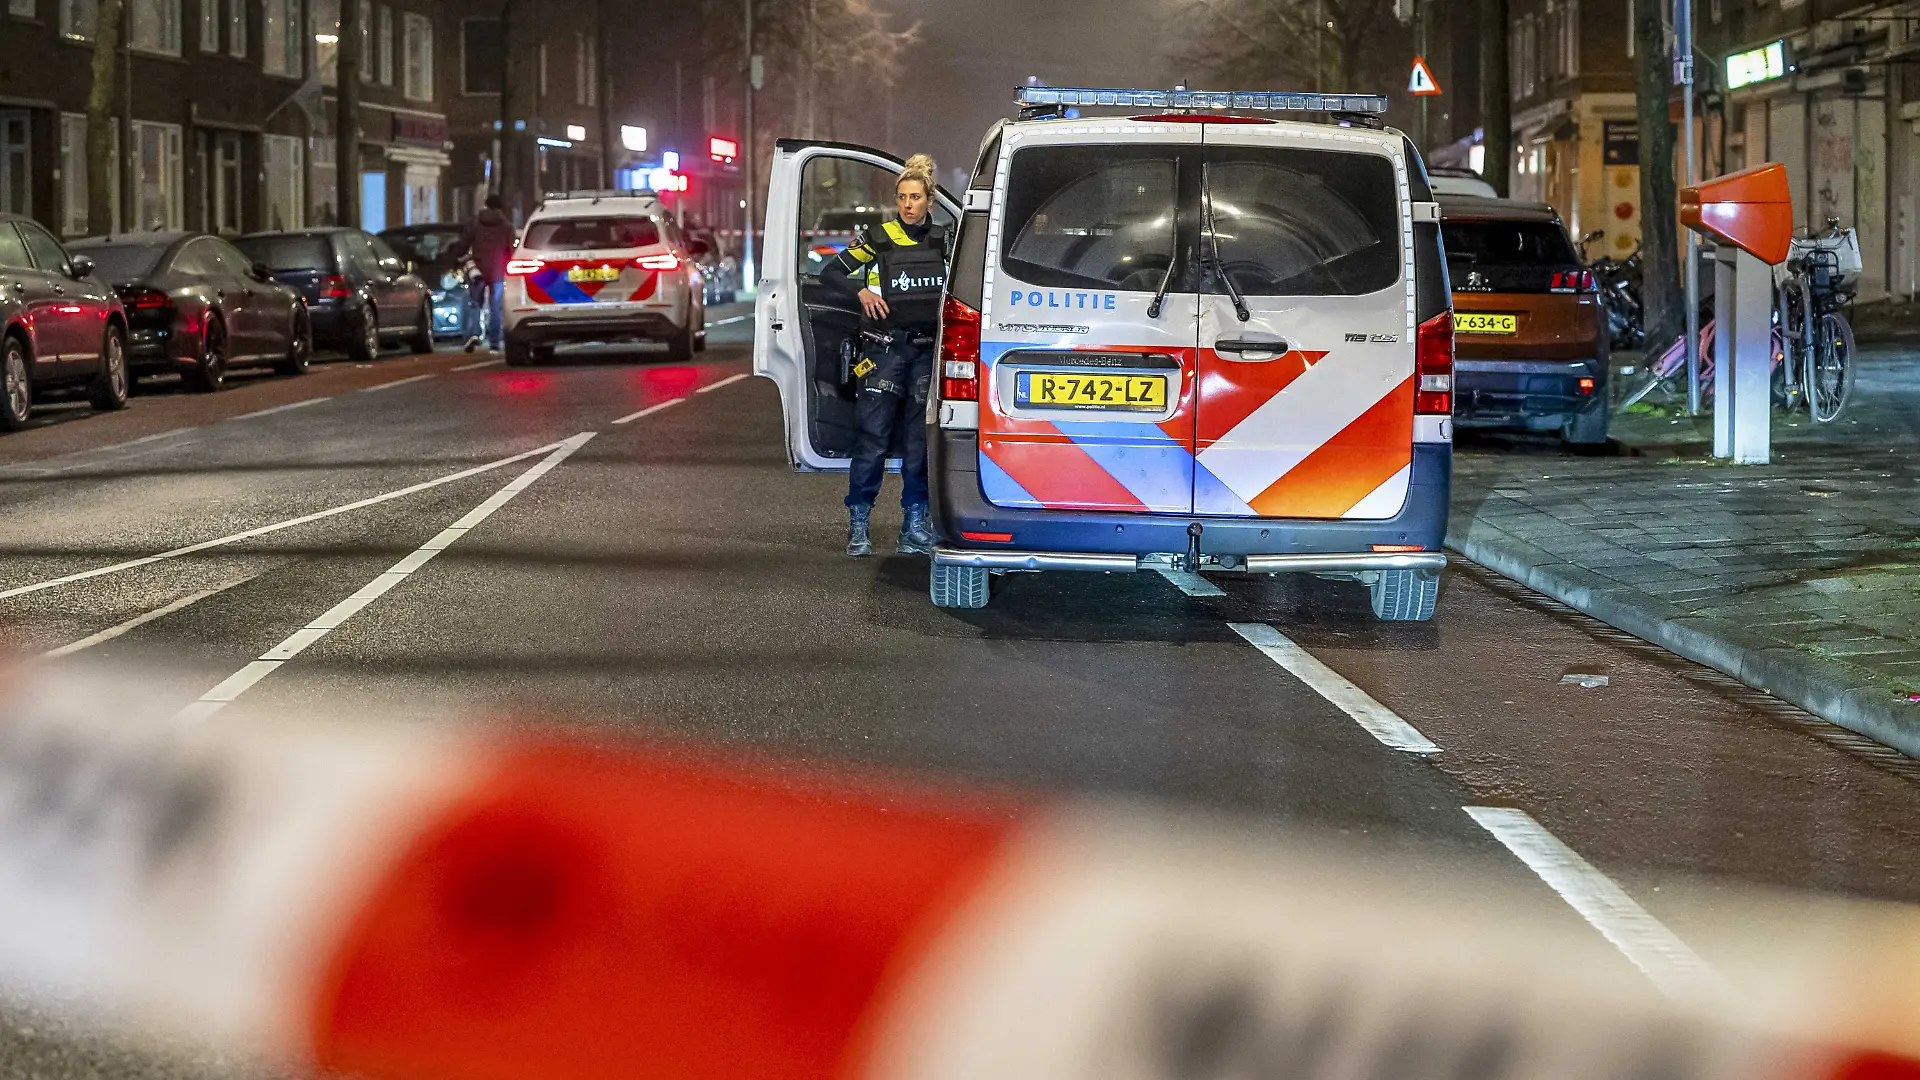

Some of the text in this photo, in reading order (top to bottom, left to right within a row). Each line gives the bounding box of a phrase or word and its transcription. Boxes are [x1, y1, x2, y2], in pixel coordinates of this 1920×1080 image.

[1010, 290, 1116, 310] POLITIE
[1058, 355, 1122, 366] Mercedes-Benz
[1041, 378, 1153, 402] R-742-LZ
